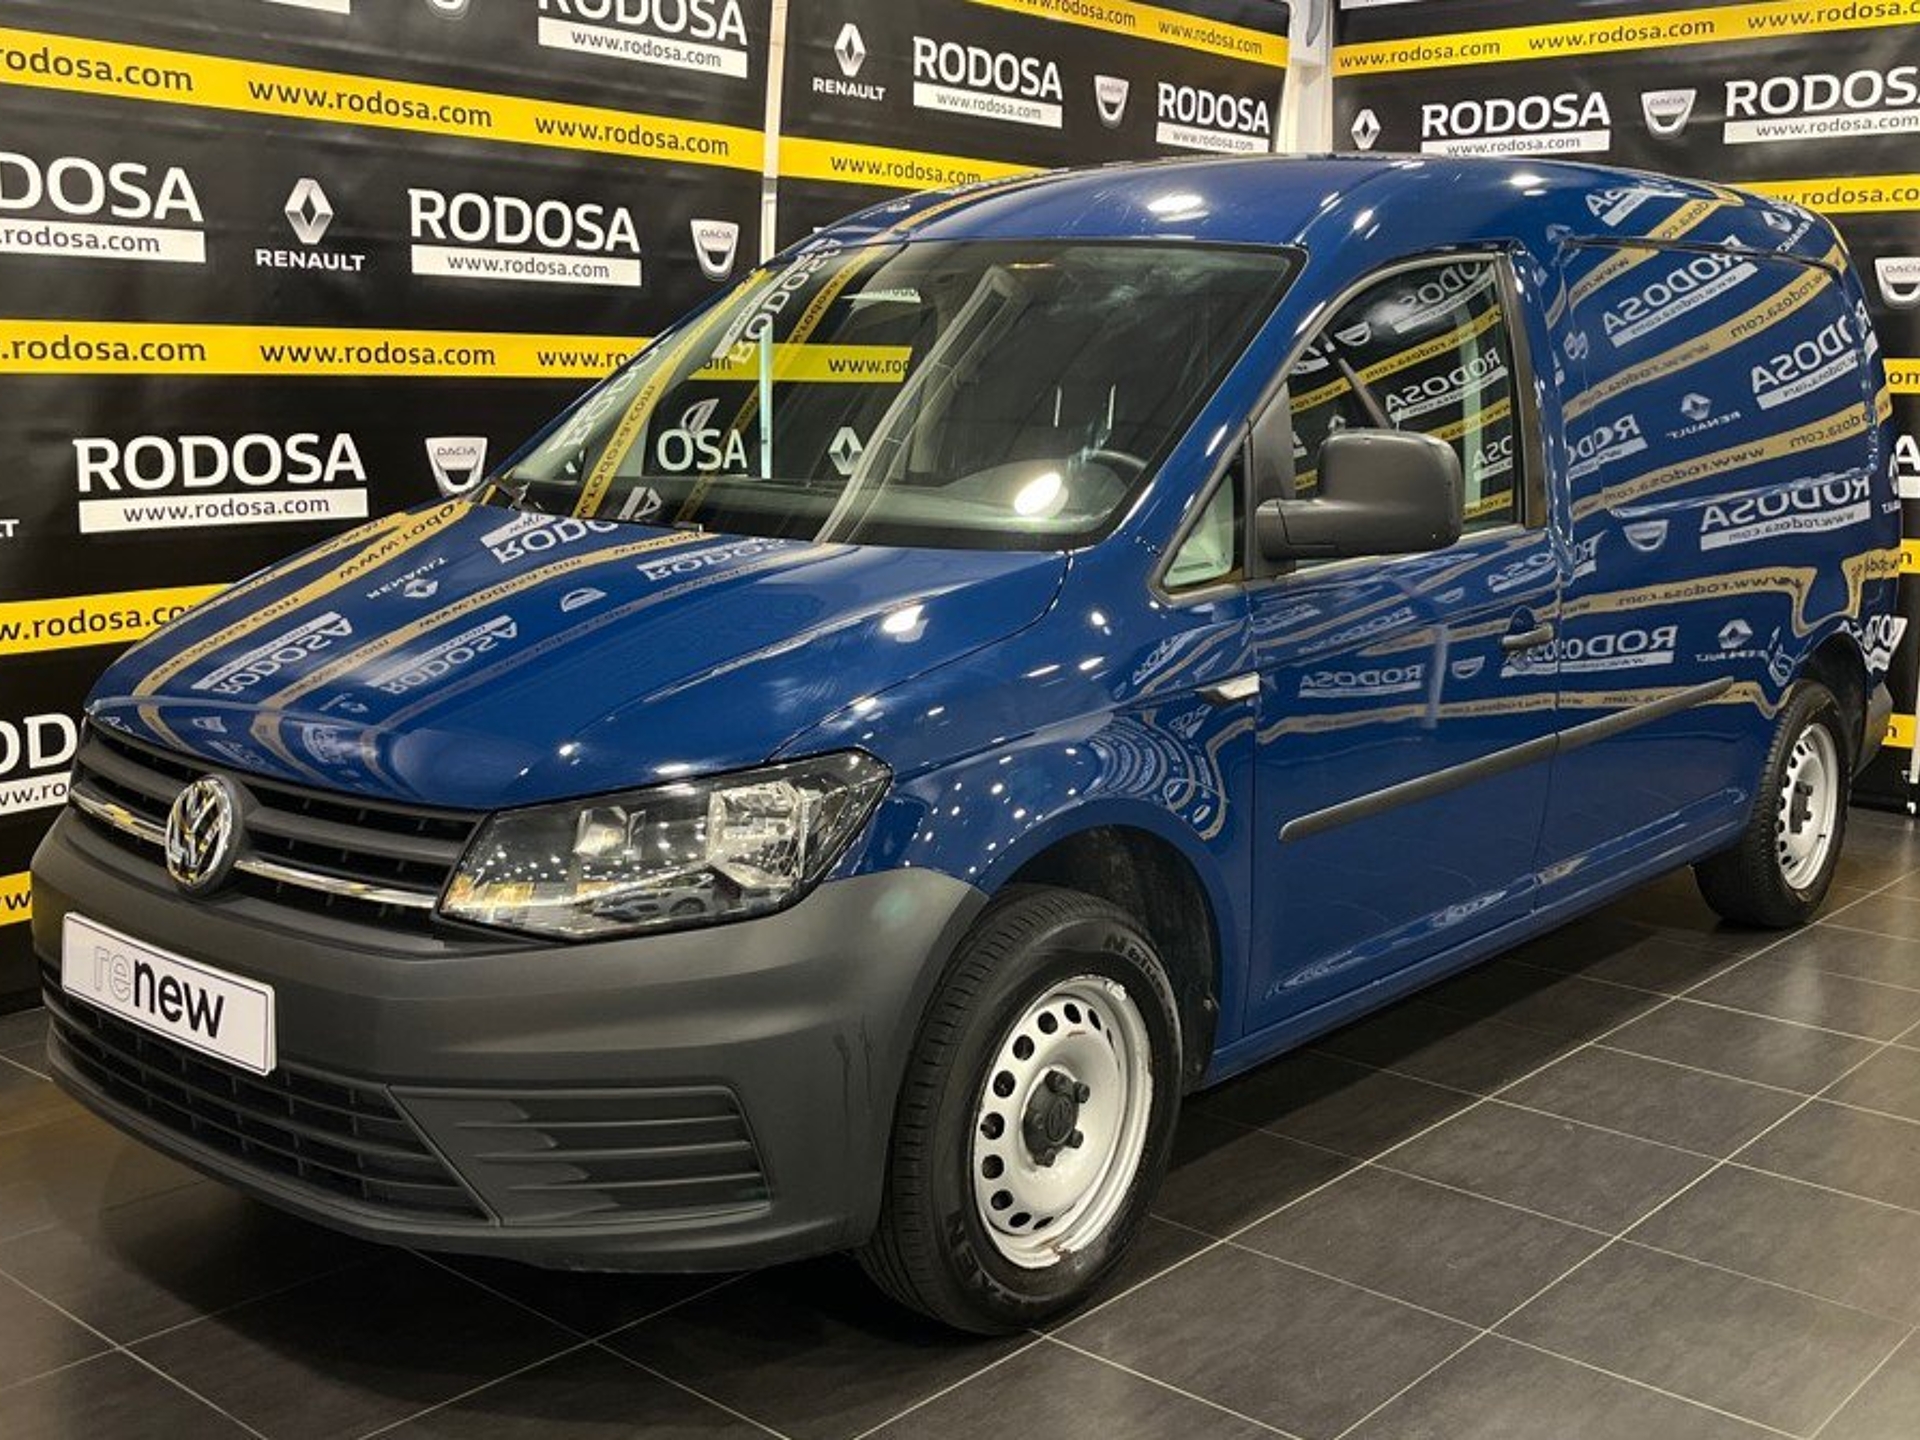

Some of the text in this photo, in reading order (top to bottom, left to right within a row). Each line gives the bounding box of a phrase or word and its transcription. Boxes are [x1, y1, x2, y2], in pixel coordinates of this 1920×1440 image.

[571, 30, 722, 67] www.rodosa.com
[1157, 19, 1262, 55] www.rodosa.com
[1529, 18, 1715, 51] www.rodosa.com
[0, 47, 193, 91] odosa.com
[913, 36, 1063, 101] RODOSA
[1339, 41, 1501, 68] www.rodosa.com
[248, 80, 492, 128] www.rodosa.com
[812, 77, 887, 101] RENAULT
[936, 92, 1042, 120] www.rodosa.com
[1724, 66, 1920, 118] RODOS
[1157, 82, 1270, 134] RODOSA
[1421, 91, 1611, 138] RODOSA
[535, 116, 729, 156] www.rodosa.com
[1172, 130, 1255, 151] www.rodosa.com
[1756, 115, 1919, 137] www.rodosa.com
[1447, 138, 1580, 155] www.rodosa.com
[830, 156, 981, 184] www.rodosa.com
[408, 188, 640, 252] RODOSA
[255, 248, 366, 271] RENAULT
[447, 255, 610, 279] www.rodosa.com
[260, 340, 496, 368] www.rodosa.com
[73, 433, 367, 492] RODOSA
[437, 446, 477, 457] DACIA
[124, 496, 330, 523] www.rodosa.com
[0, 605, 196, 641] w.rodosa.co
[94, 945, 225, 1038] renew
